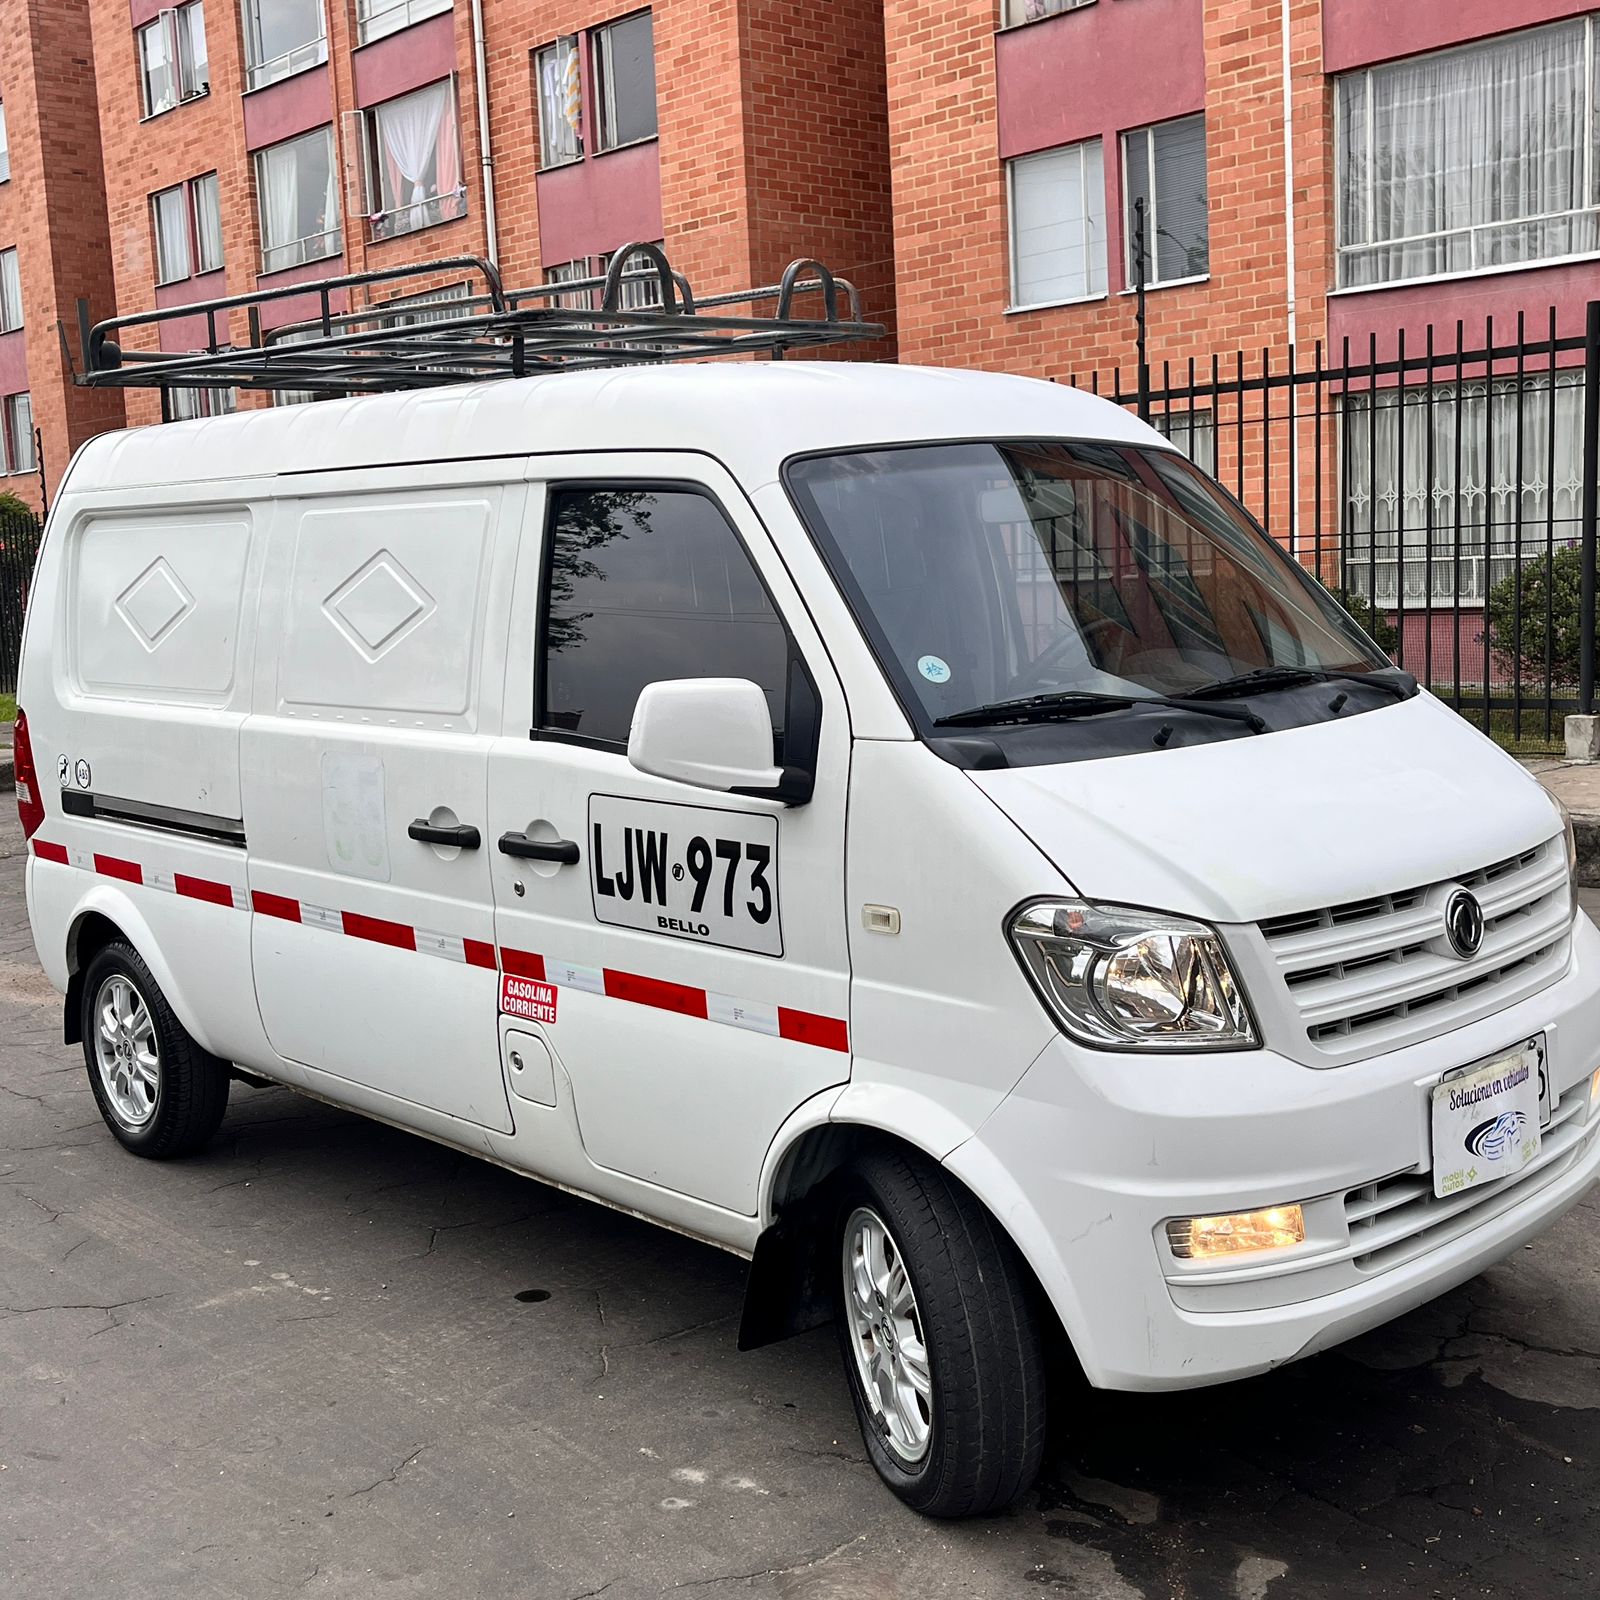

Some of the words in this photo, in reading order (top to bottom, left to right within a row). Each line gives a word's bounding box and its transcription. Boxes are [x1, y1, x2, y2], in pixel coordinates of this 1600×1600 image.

[594, 823, 668, 907] LJW
[686, 836, 772, 925] 973
[657, 916, 710, 936] BELLO
[507, 979, 552, 1004] GASOLINA
[504, 995, 555, 1022] CORRIENTE
[1449, 1083, 1493, 1111] Soluciones
[1492, 1079, 1503, 1096] en
[1441, 1168, 1464, 1184] mobil
[1442, 1179, 1464, 1193] autos
